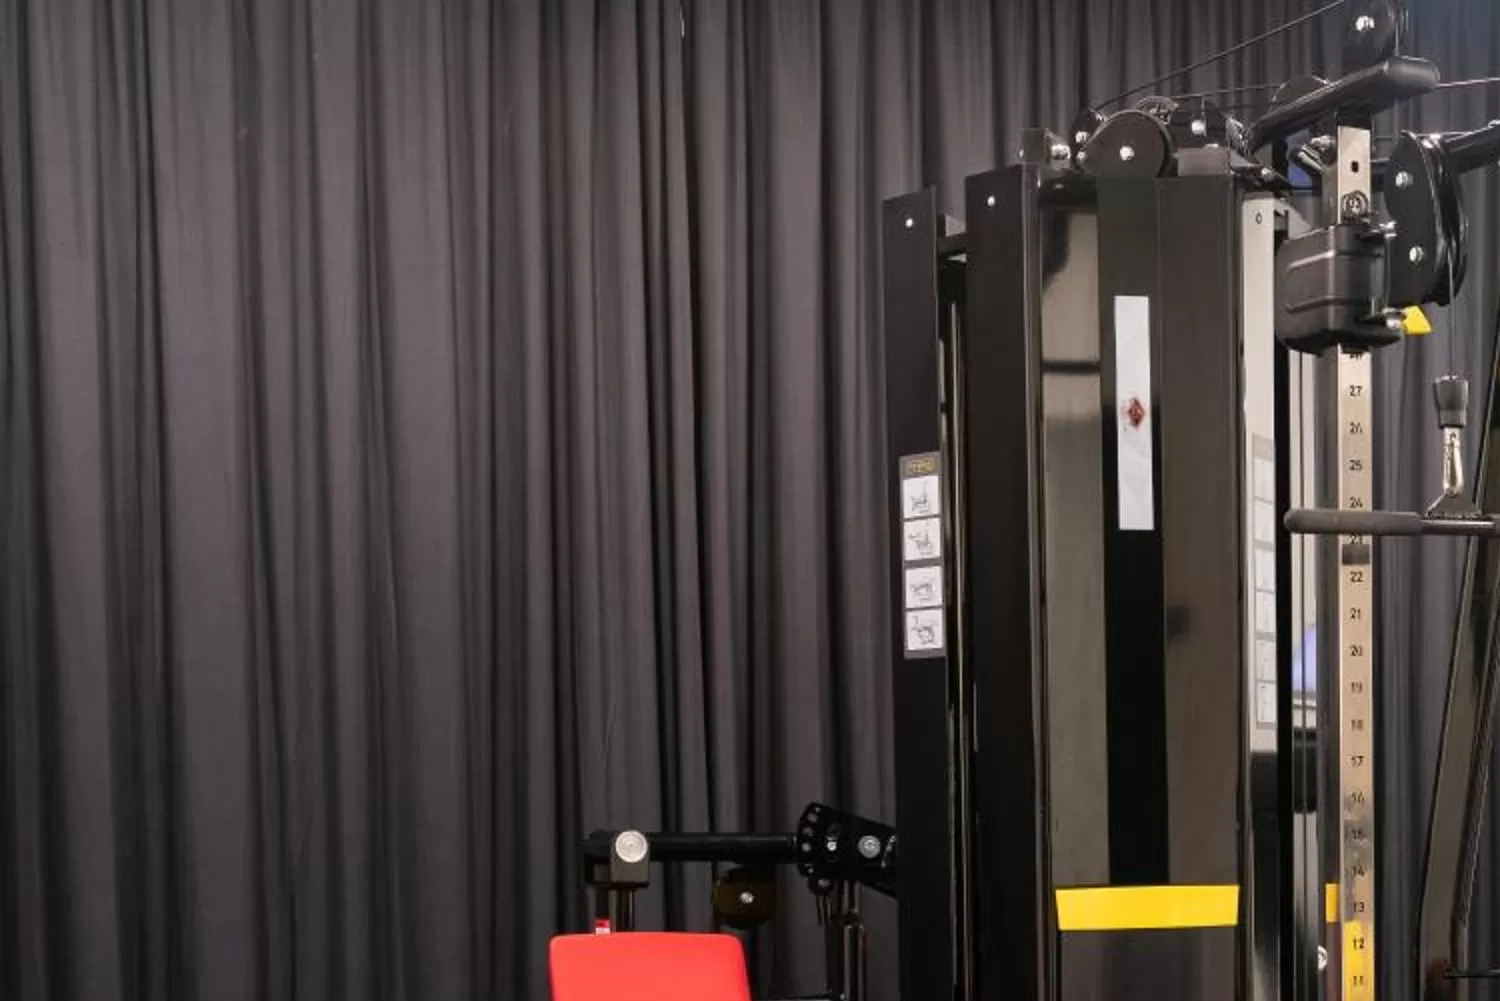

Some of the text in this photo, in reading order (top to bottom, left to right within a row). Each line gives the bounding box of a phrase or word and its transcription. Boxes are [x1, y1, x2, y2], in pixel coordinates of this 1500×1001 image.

[1349, 385, 1363, 397] 27
[1349, 459, 1363, 471] 25
[1349, 497, 1364, 508] 24
[1349, 571, 1364, 583] 22
[1349, 608, 1362, 620] 21
[1349, 645, 1364, 657] 20
[1351, 755, 1364, 767] 17
[1352, 902, 1365, 913] 13
[1352, 939, 1366, 950] 12
[1352, 975, 1365, 986] 11
